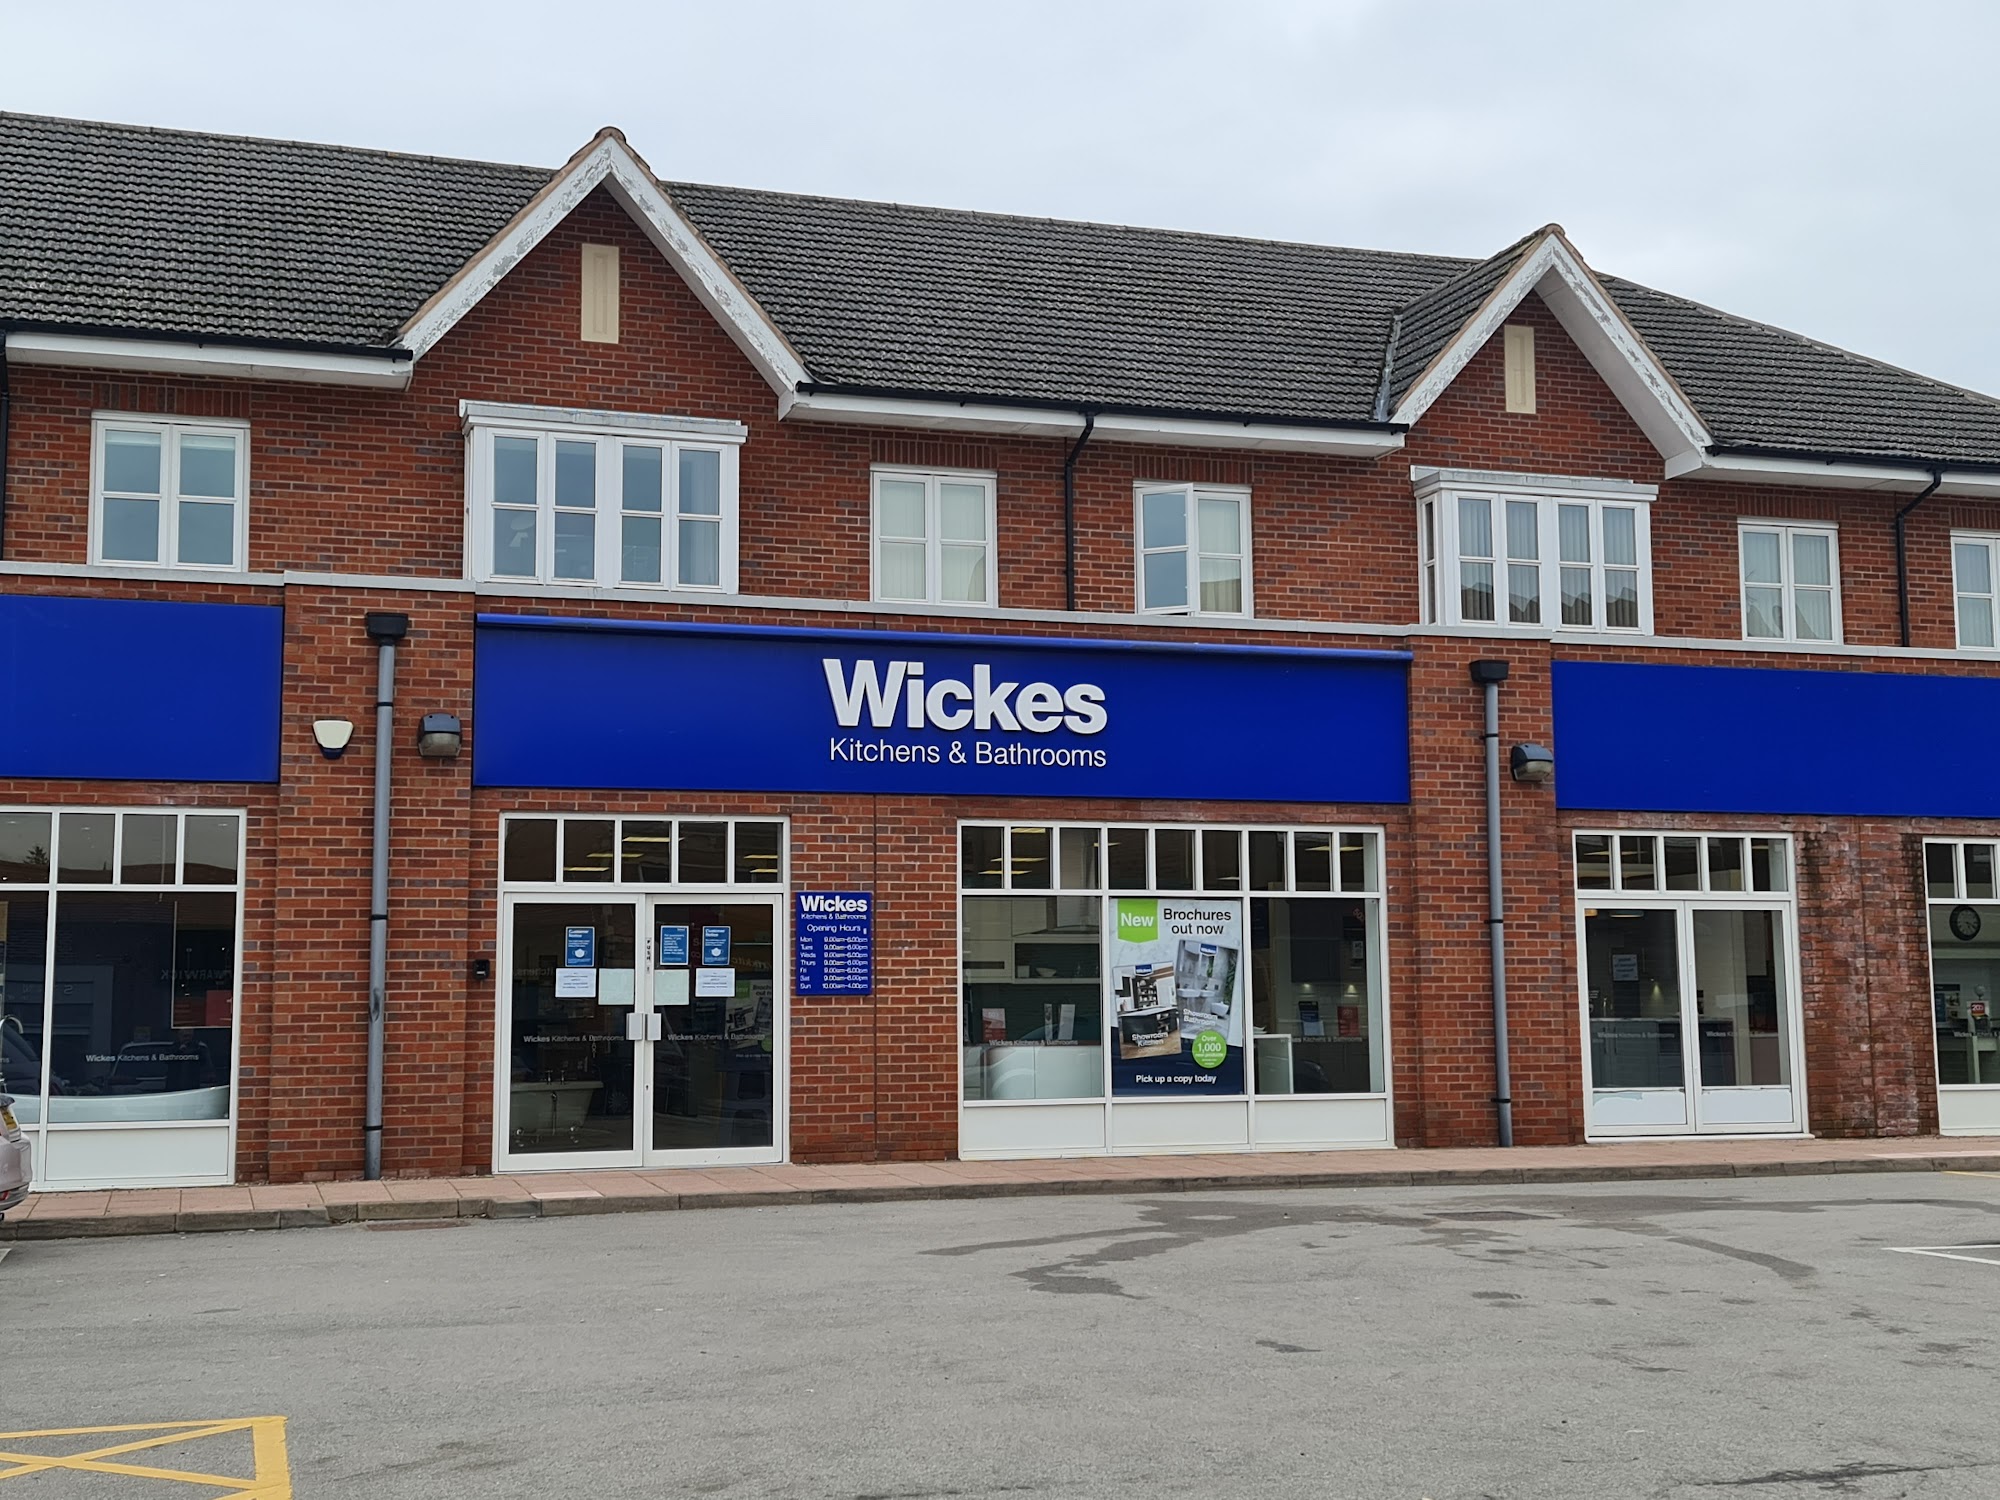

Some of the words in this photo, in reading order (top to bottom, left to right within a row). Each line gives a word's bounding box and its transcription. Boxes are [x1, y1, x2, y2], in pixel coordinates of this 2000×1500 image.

[822, 658, 1108, 734] Wickes
[829, 737, 941, 763] Kitchens
[949, 741, 967, 763] &
[976, 741, 1107, 767] Bathrooms
[800, 895, 868, 912] Wickes
[1121, 912, 1154, 927] New
[1163, 908, 1232, 921] Brochures
[807, 924, 837, 933] Opening
[840, 924, 861, 932] Hours
[1171, 924, 1192, 935] out
[1196, 926, 1224, 935] now
[1183, 1008, 1218, 1020] Showroom
[1183, 1015, 1216, 1026] Bathroom
[1132, 1031, 1168, 1041] Showroom
[1137, 1039, 1164, 1047] Kitchen
[1198, 1043, 1221, 1053] 1,000
[1136, 1075, 1153, 1083] Pick
[1155, 1077, 1165, 1085] up
[1173, 1077, 1192, 1085] copy
[1194, 1075, 1217, 1085] today
